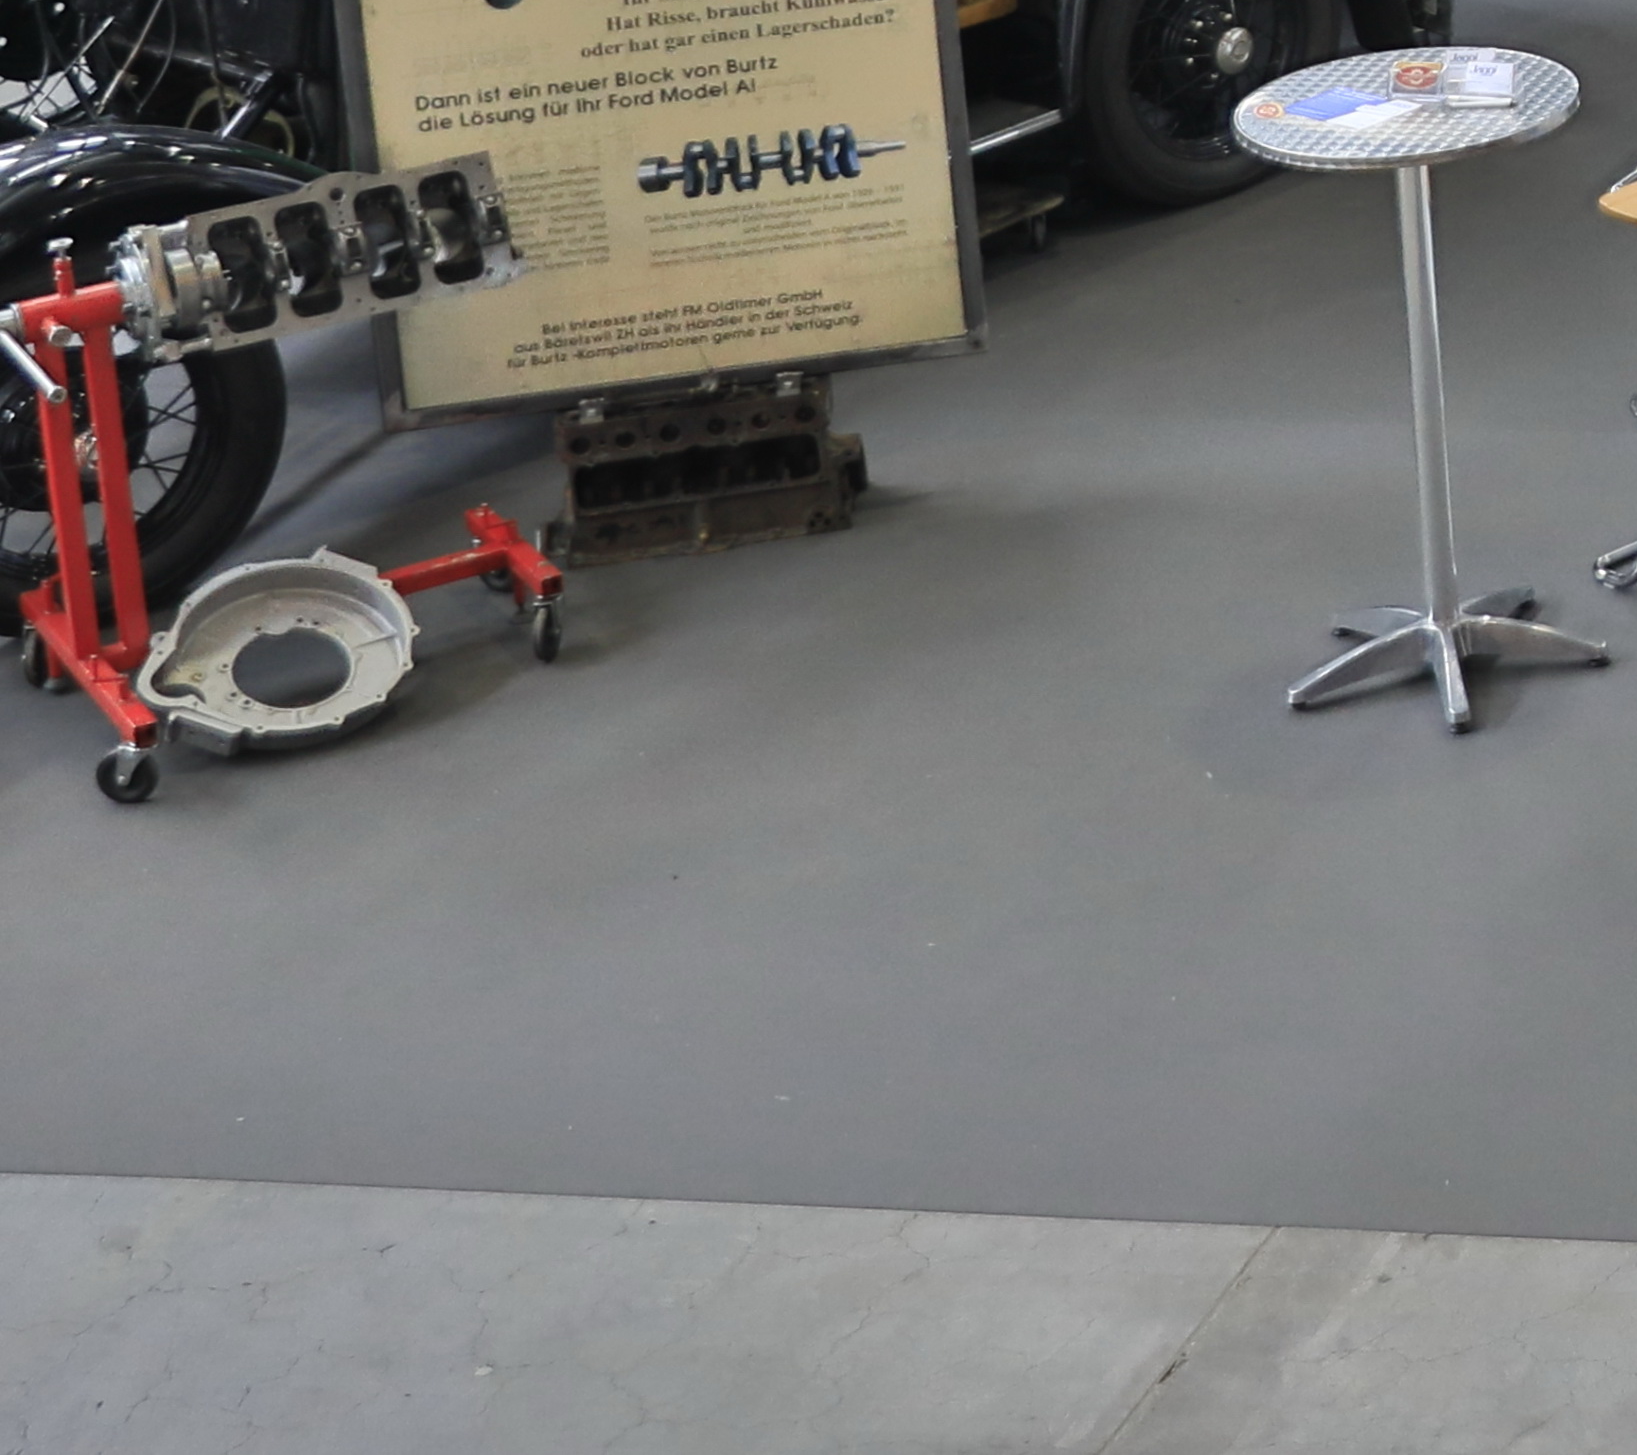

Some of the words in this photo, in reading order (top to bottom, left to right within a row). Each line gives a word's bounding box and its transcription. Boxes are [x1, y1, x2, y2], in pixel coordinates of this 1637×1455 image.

[580, 41, 622, 60] oder
[628, 36, 660, 53] hat
[664, 32, 696, 52] gar
[701, 27, 750, 45] einen
[755, 8, 896, 42] Lagerschaden?
[606, 14, 642, 33] Hat
[646, 7, 702, 29] Risse,
[415, 91, 471, 112] Dann
[477, 86, 502, 105] ist
[509, 81, 541, 102] ein
[547, 76, 609, 97] neuer
[614, 67, 675, 89] Block
[682, 61, 721, 80] von
[726, 55, 779, 75] Burtz
[418, 113, 454, 133] die
[459, 103, 538, 131] Lösung
[542, 99, 570, 119] für
[576, 96, 602, 114] Ihr
[607, 88, 656, 110] Ford
[660, 80, 730, 105] Model
[706, 294, 773, 316] Oldtimer
[777, 288, 824, 307] GmbH
[765, 305, 790, 322] der
[794, 299, 855, 319] Schweiz
